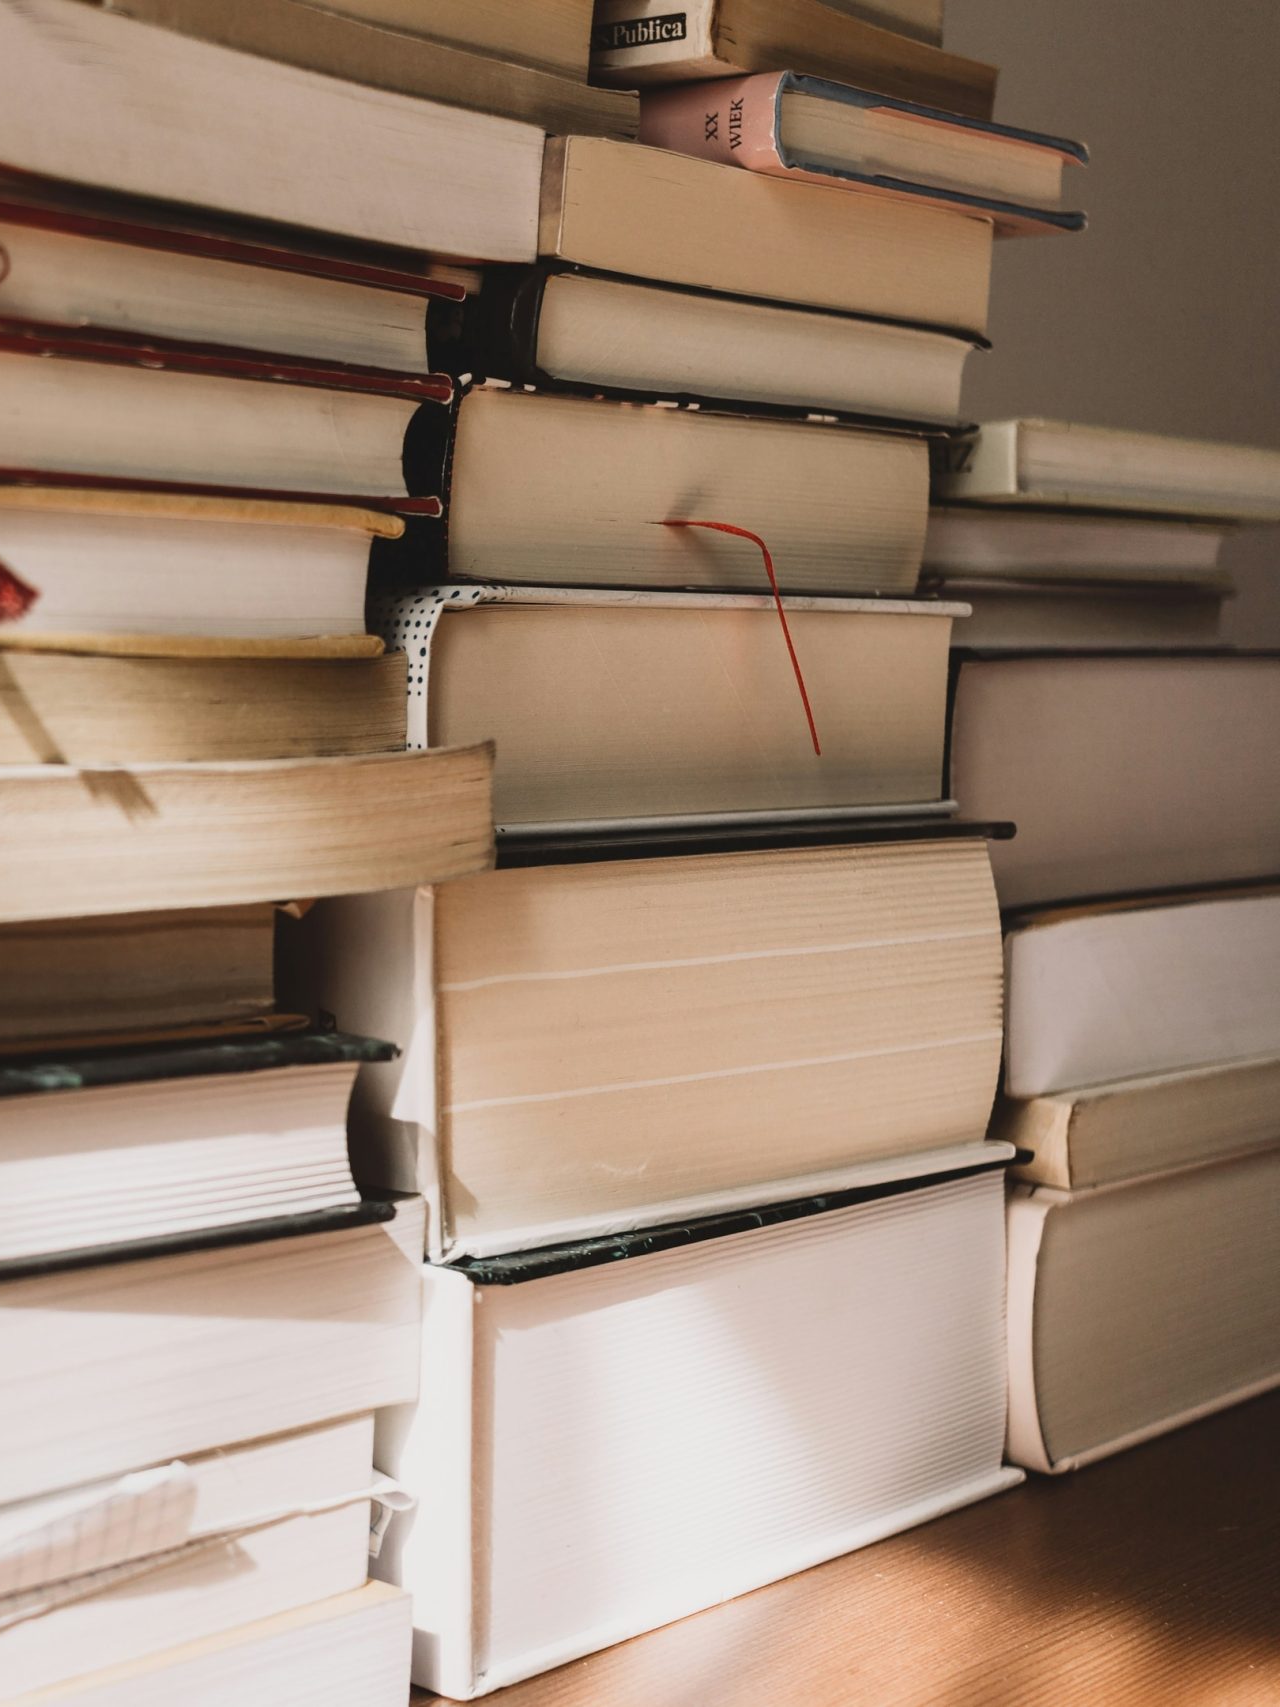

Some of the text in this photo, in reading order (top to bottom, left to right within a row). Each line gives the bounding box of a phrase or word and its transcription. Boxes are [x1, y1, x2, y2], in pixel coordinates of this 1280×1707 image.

[613, 18, 683, 46] Publica
[705, 111, 719, 142] XX
[729, 96, 745, 151] WIEK
